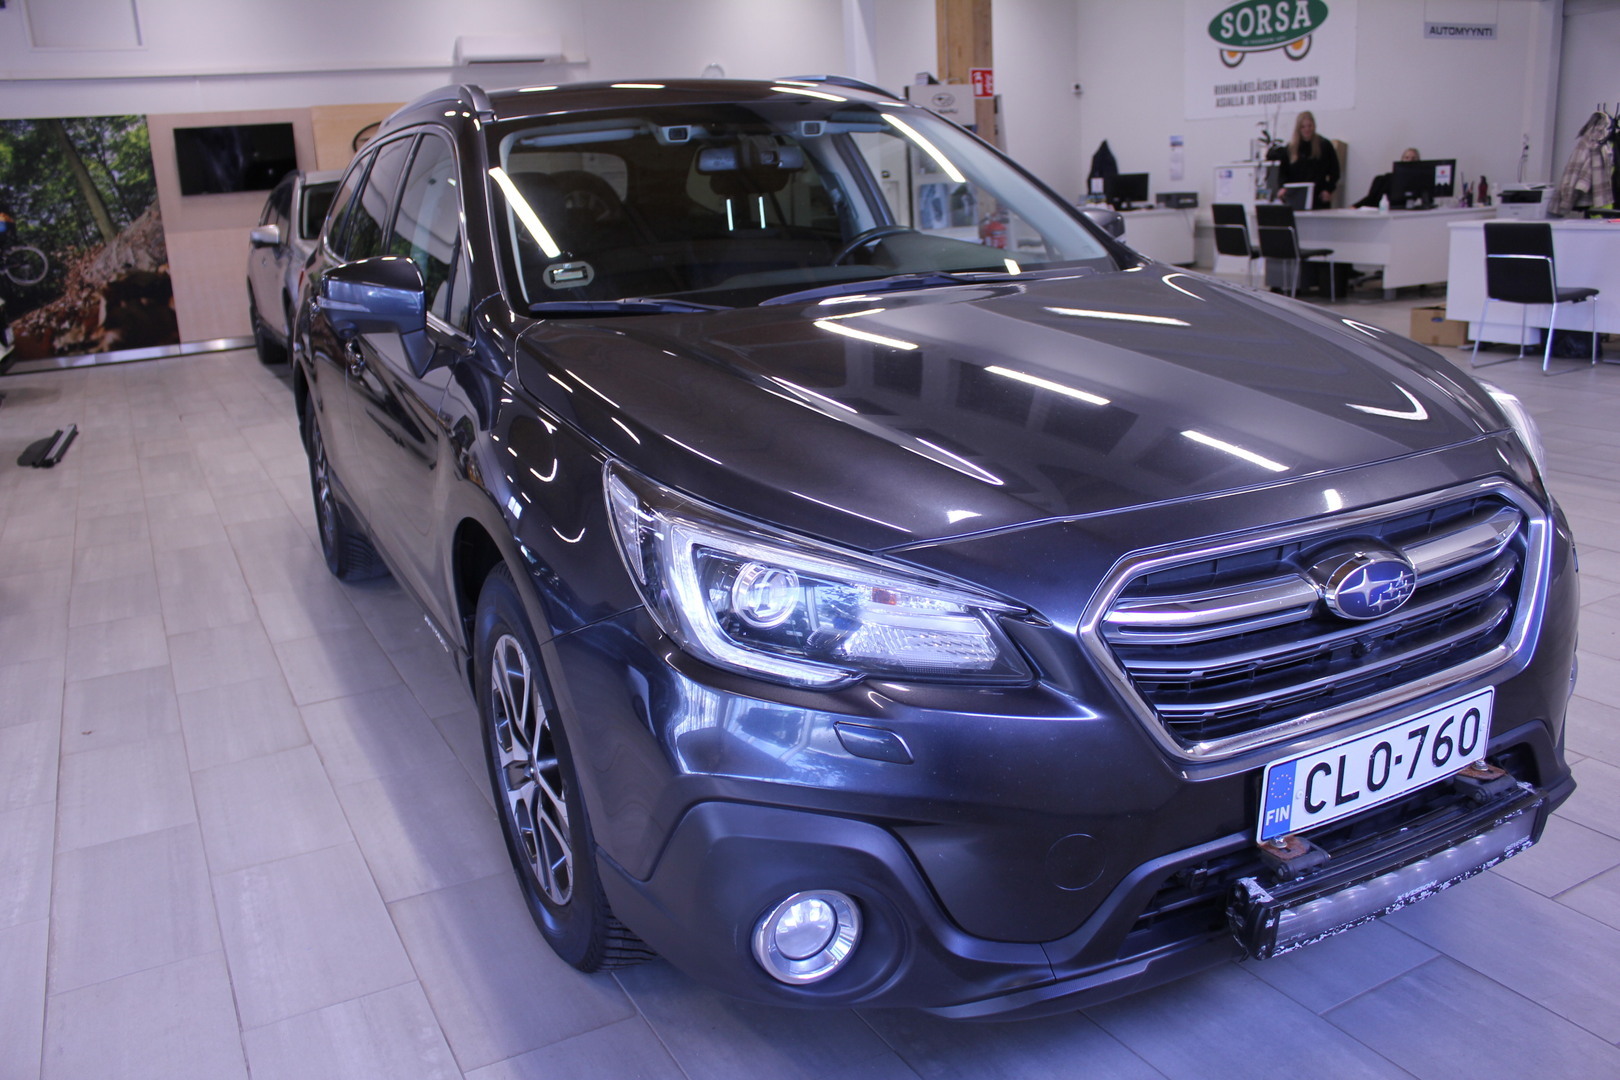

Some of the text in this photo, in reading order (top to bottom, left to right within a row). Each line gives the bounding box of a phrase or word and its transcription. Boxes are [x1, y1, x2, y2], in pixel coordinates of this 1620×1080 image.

[1220, 1, 1312, 39] SORSA
[1429, 26, 1493, 37] AUTOMYYNTI
[1304, 707, 1480, 814] CLO-760
[1265, 805, 1290, 826] FIN
